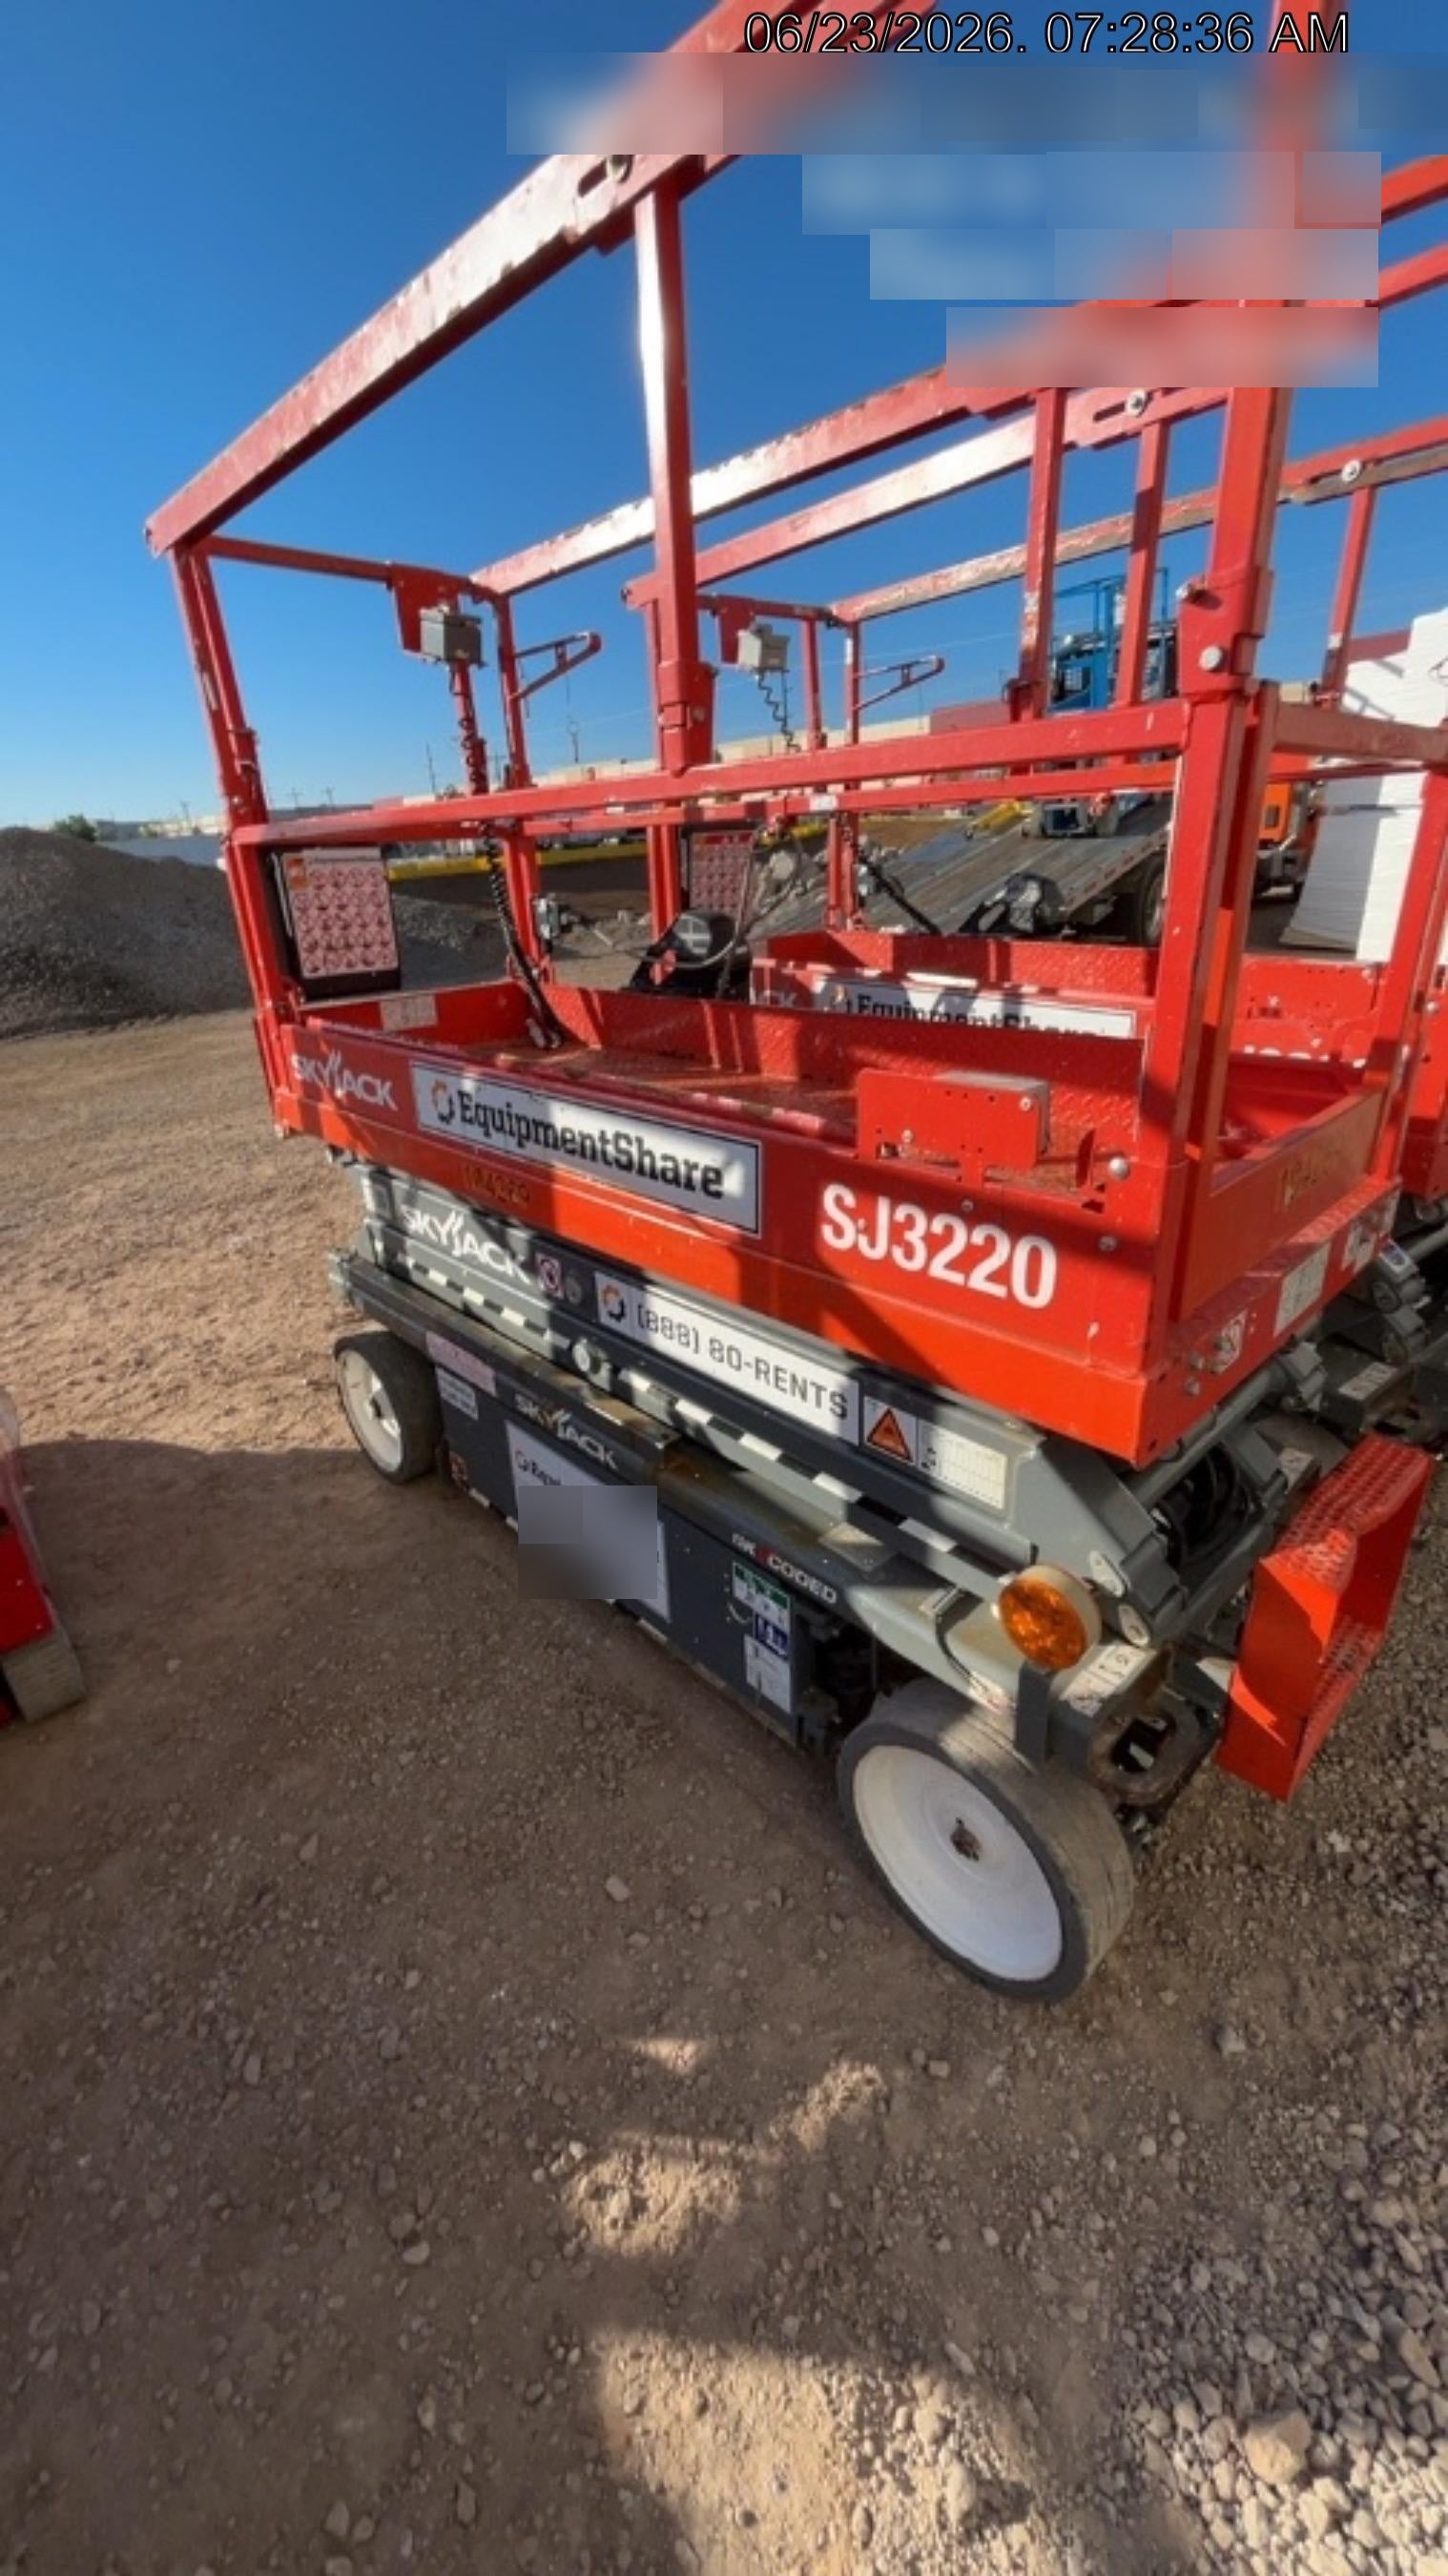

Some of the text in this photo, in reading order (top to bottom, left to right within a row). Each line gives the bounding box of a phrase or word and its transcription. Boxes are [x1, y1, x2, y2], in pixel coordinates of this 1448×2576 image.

[291, 1049, 398, 1111] SKYJACK
[457, 1090, 724, 1199] EquipmentShare
[400, 1204, 531, 1284] SKYJACK
[820, 1183, 1058, 1309] SJ3220
[637, 1303, 848, 1420] (888) 80-RENTS
